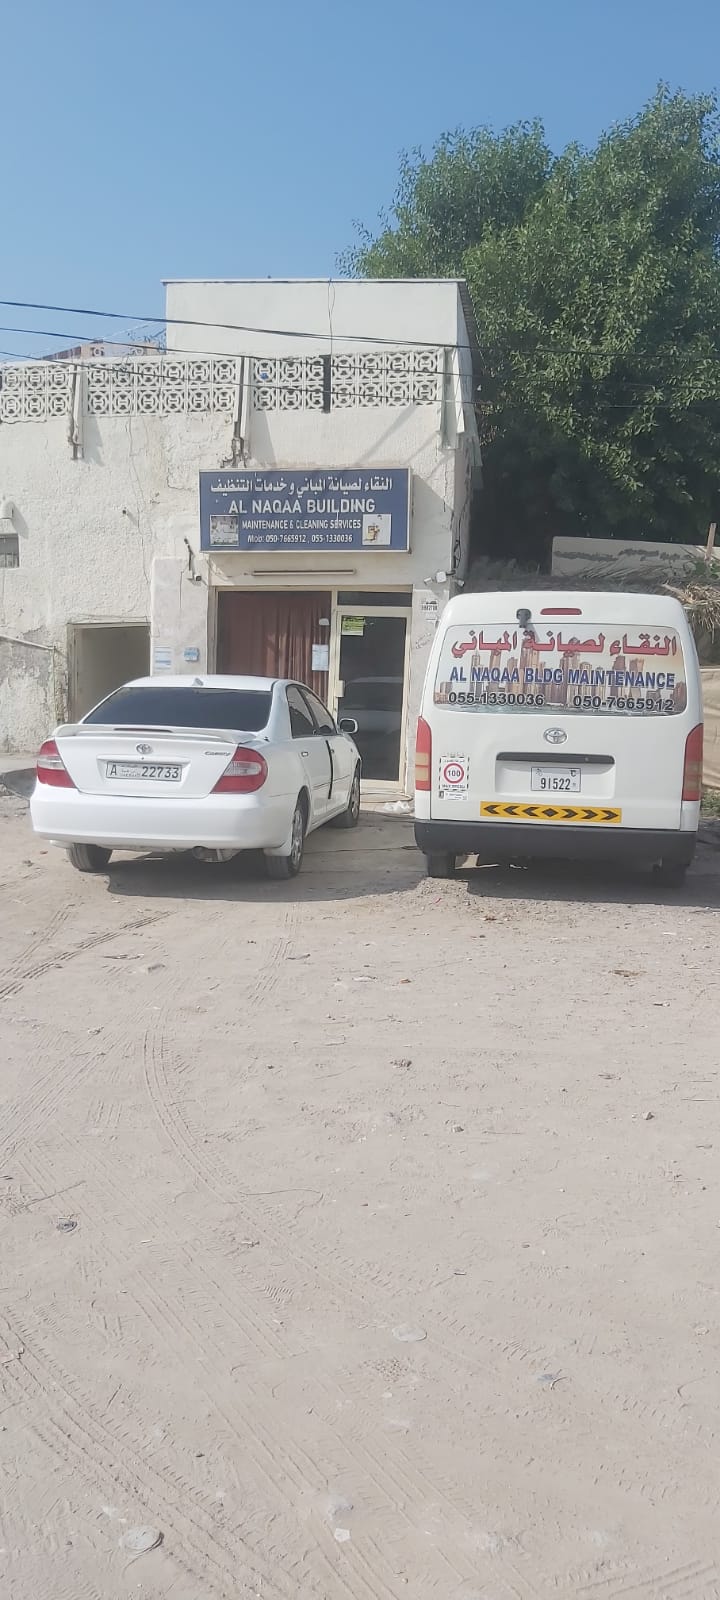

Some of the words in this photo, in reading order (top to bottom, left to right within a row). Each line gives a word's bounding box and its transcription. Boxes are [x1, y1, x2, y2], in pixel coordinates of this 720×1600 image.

[210, 478, 253, 497] التنظيف
[254, 477, 288, 492] خدمات
[296, 477, 326, 499] المباني
[328, 475, 363, 495] لصيانة
[364, 475, 394, 493] النقاء
[228, 499, 248, 514] AL
[252, 499, 302, 514] NAQAA
[306, 498, 376, 513] BUILDING
[242, 520, 288, 530] MAINTENANCE
[295, 519, 329, 529] CLEANING
[329, 519, 362, 529] SERVICES
[451, 629, 518, 658] المباني
[522, 629, 606, 658] لصيانة
[609, 632, 677, 656] النقاء
[449, 666, 467, 682] AL
[471, 666, 520, 682] NAQAA
[525, 667, 563, 684] BLDG
[568, 668, 676, 690] MAINTENANCE
[448, 691, 545, 706] 055-1330036
[572, 695, 674, 711] 050-7665912
[109, 764, 117, 776] A
[141, 765, 179, 779] 22733
[540, 777, 571, 790] 91522
